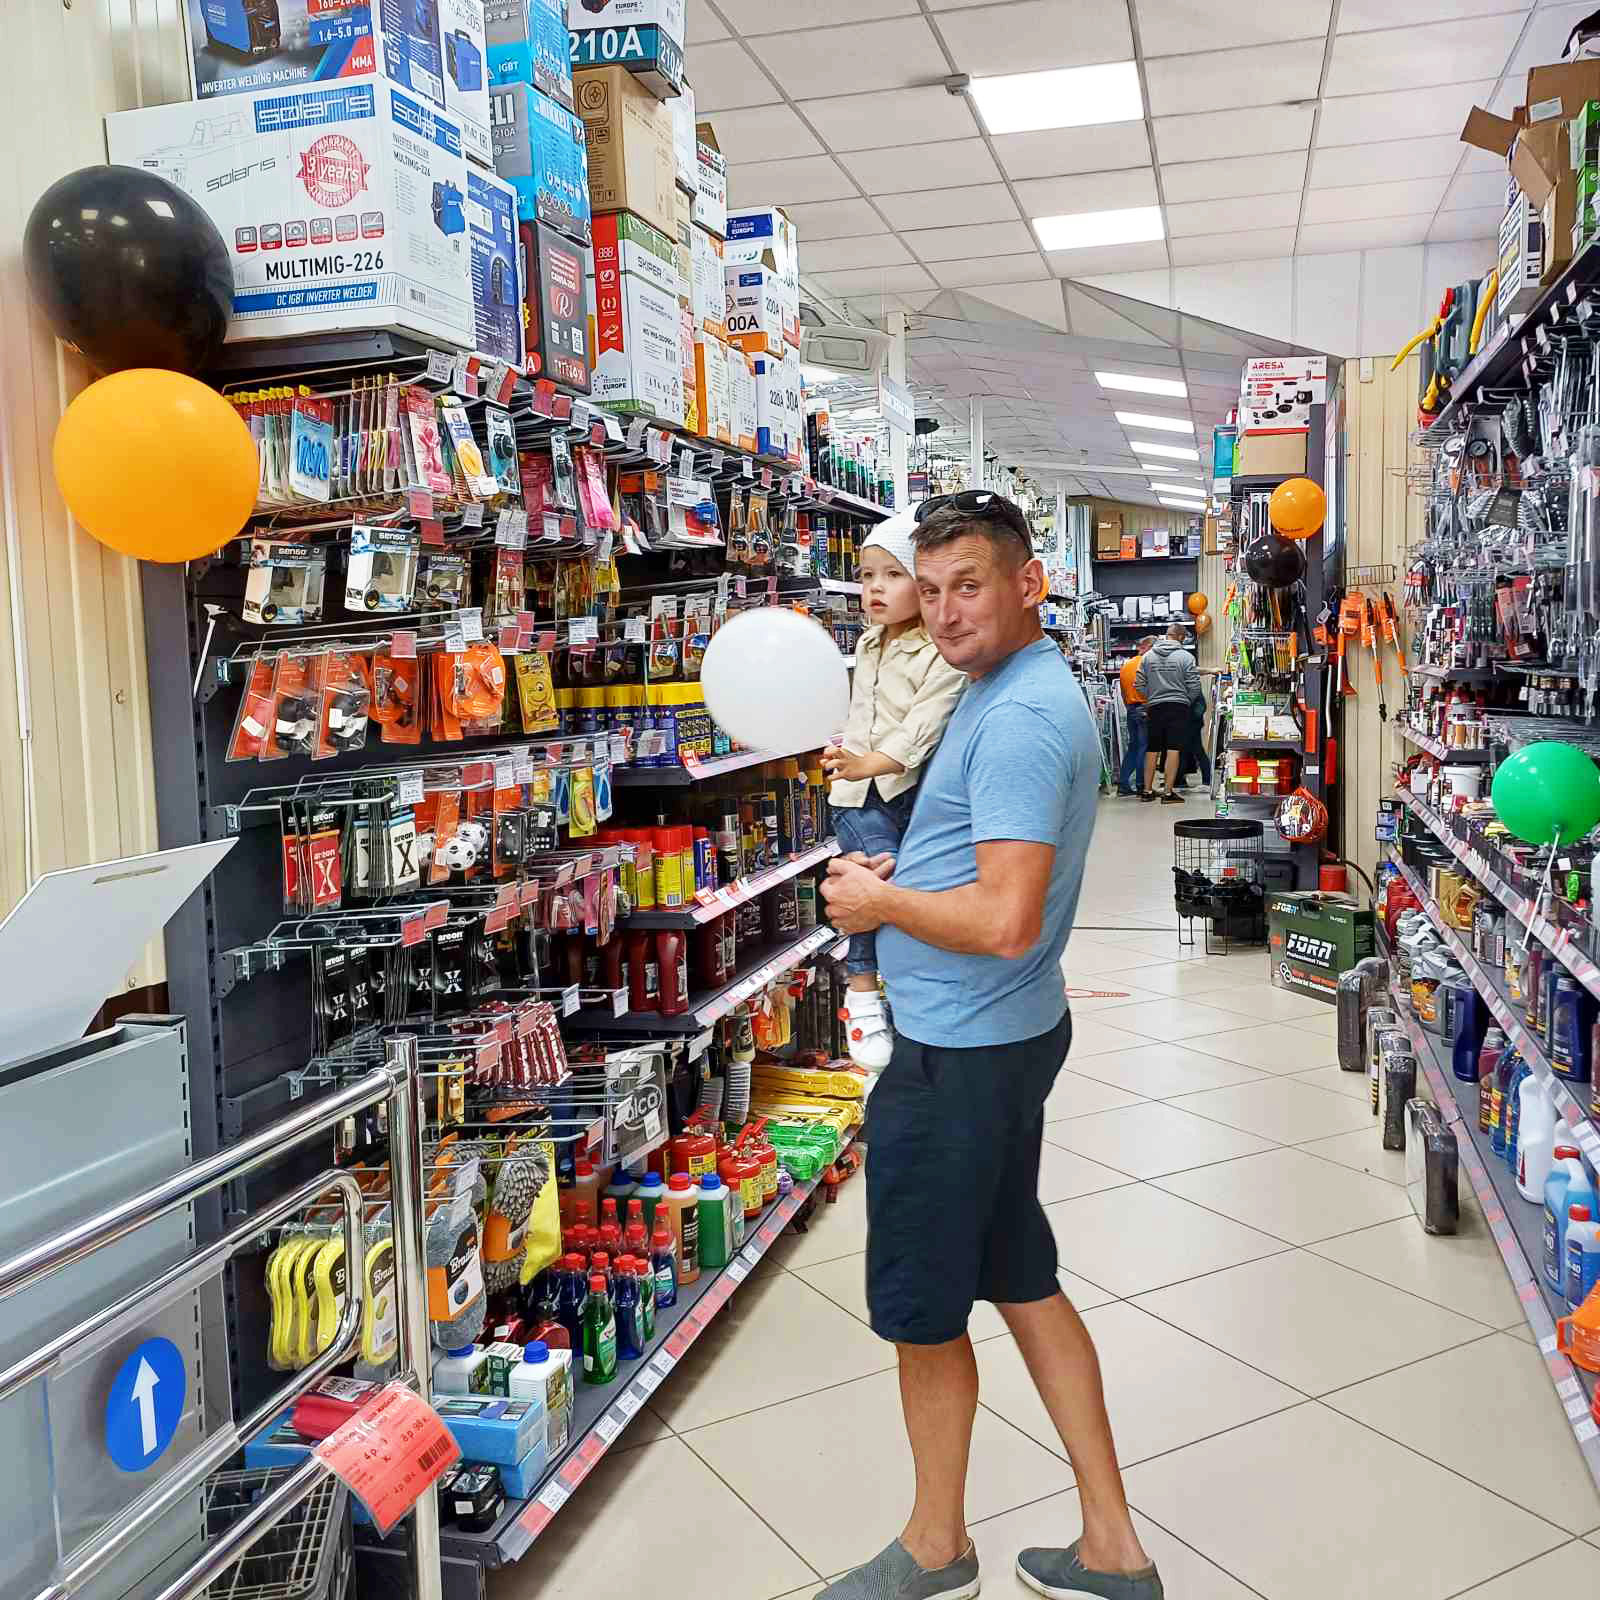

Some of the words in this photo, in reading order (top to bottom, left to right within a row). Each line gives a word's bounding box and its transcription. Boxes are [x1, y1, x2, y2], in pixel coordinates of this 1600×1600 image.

[354, 24, 368, 36] mm
[568, 27, 644, 61] 210A
[352, 55, 372, 69] MMA
[498, 61, 519, 73] IGBT
[201, 78, 236, 94] INVERTER
[238, 72, 272, 88] WELDING
[273, 67, 308, 81] MACHINE
[307, 155, 317, 173] 3
[320, 163, 360, 182] years
[265, 250, 384, 281] MULTIMIG-226
[307, 288, 341, 303] INVERTER
[343, 286, 373, 300] WELDER
[727, 315, 759, 331] 00A
[1252, 361, 1285, 369] ARESA
[603, 382, 627, 390] EUROPE
[393, 831, 414, 844] areon
[313, 848, 335, 861] areon
[396, 839, 417, 879] X
[314, 857, 339, 898] X
[437, 931, 464, 943] areon
